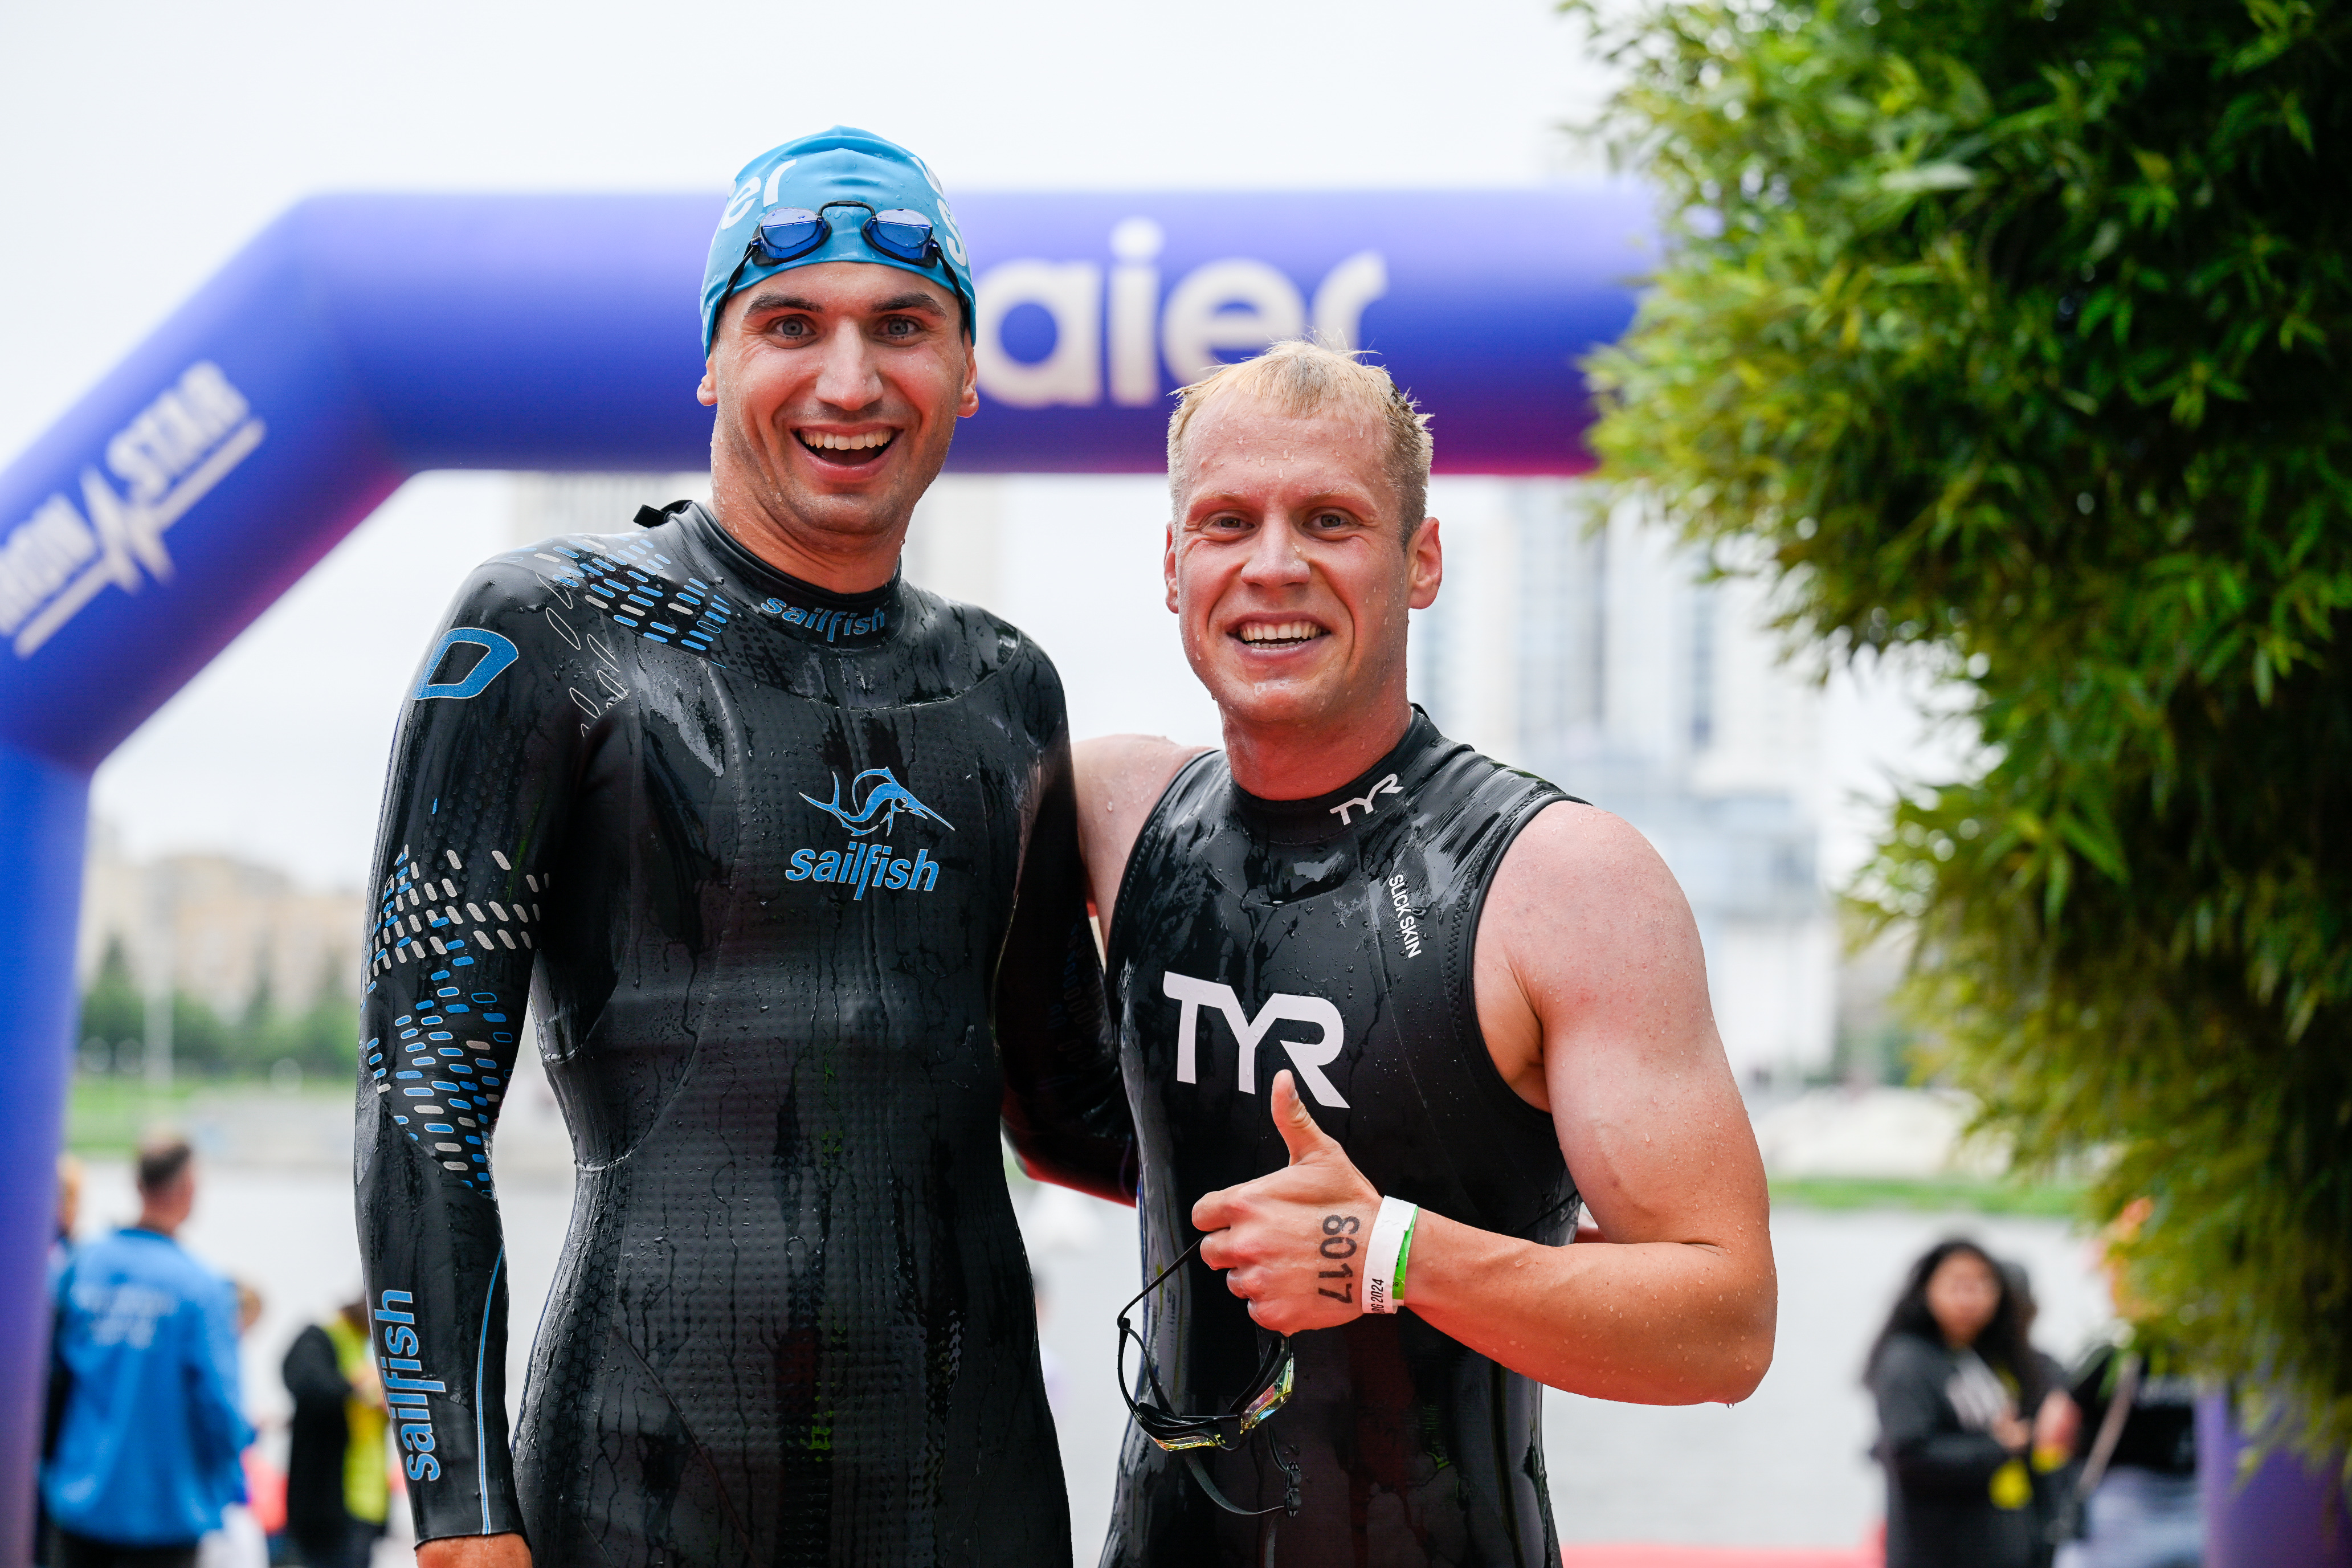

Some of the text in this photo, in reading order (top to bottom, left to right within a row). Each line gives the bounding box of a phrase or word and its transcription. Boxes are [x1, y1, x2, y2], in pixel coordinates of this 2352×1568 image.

[106, 360, 251, 503] STAR
[761, 598, 884, 643] sailfish
[1329, 773, 1404, 825] TYR
[785, 841, 939, 901] sailfish
[1389, 874, 1422, 958] SLICK SKIN
[1163, 970, 1350, 1108] TYR
[1318, 1214, 1361, 1304] 8017
[1370, 1277, 1384, 1303] 2024
[374, 1289, 446, 1481] sailfish
